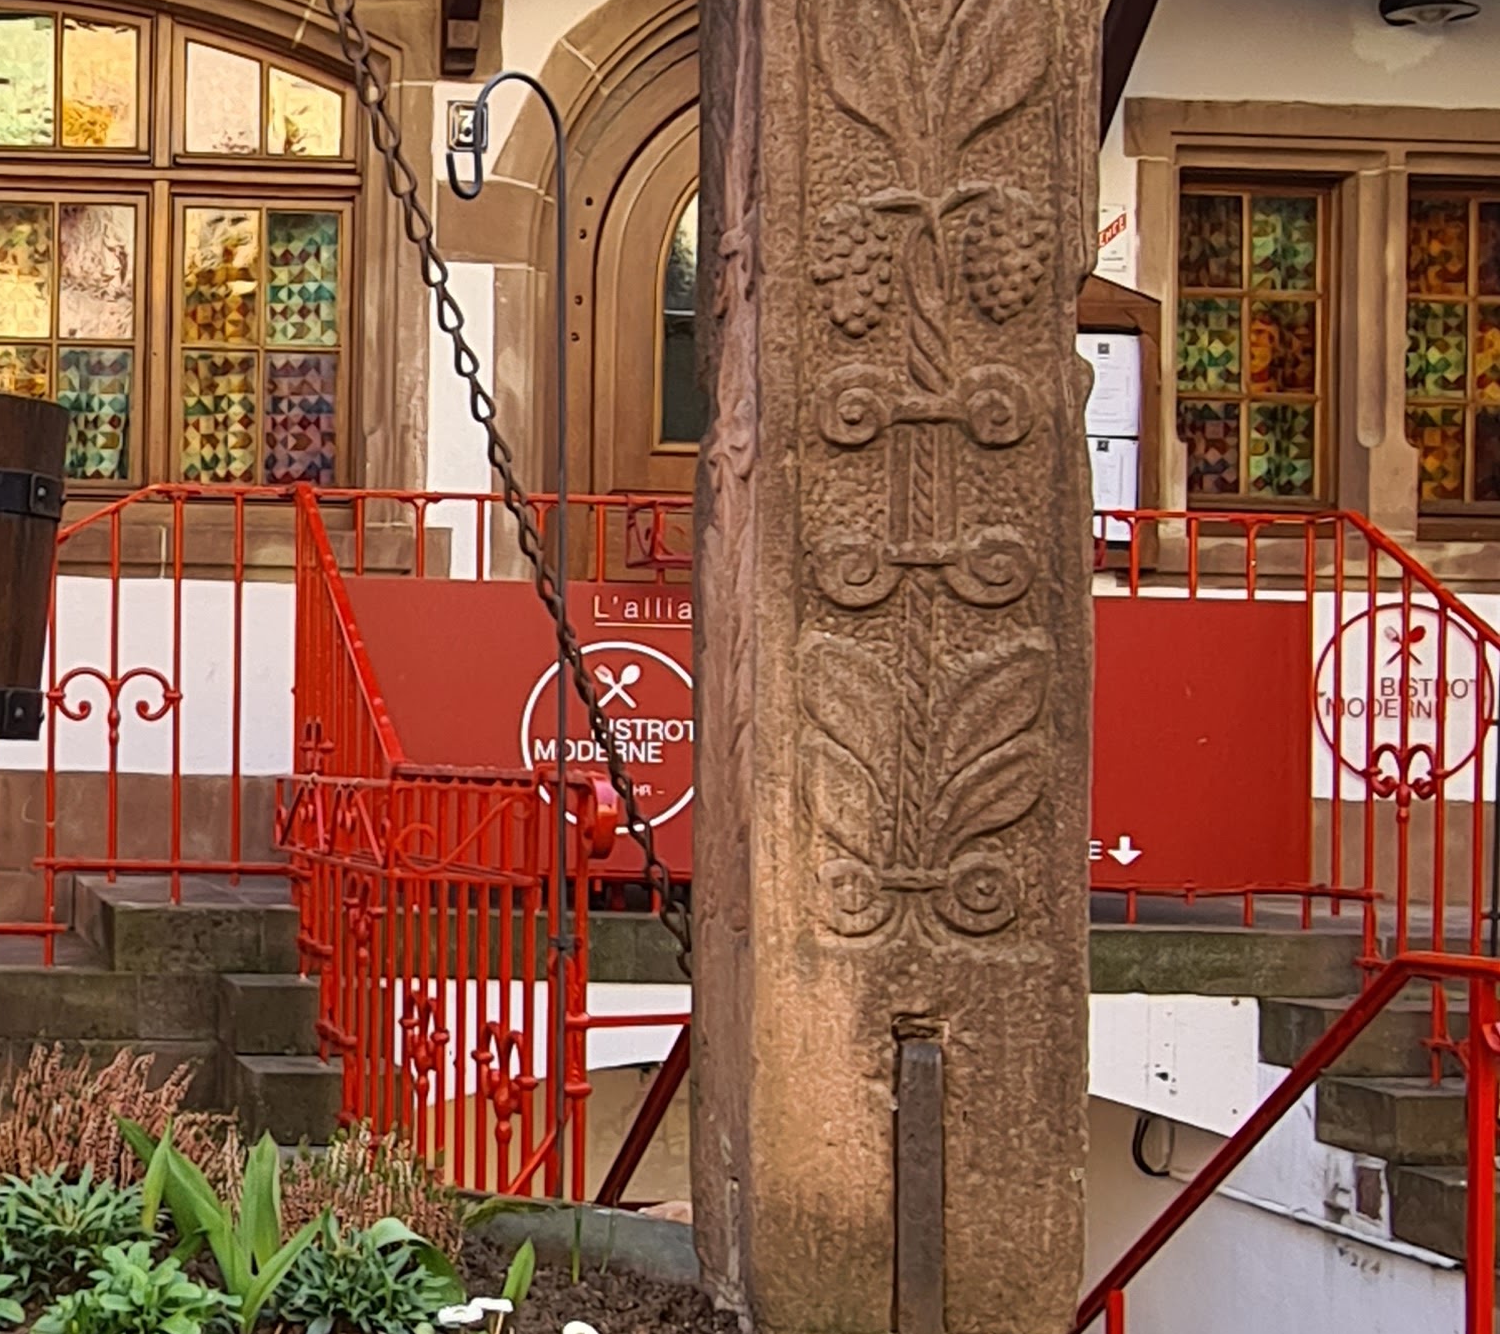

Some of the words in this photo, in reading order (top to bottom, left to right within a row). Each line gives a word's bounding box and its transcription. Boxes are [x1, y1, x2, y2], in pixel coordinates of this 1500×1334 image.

[593, 594, 693, 620] L'allia
[1380, 676, 1479, 700] BSTO
[1325, 696, 1446, 720] MODERN
[590, 717, 695, 742] ISTROT
